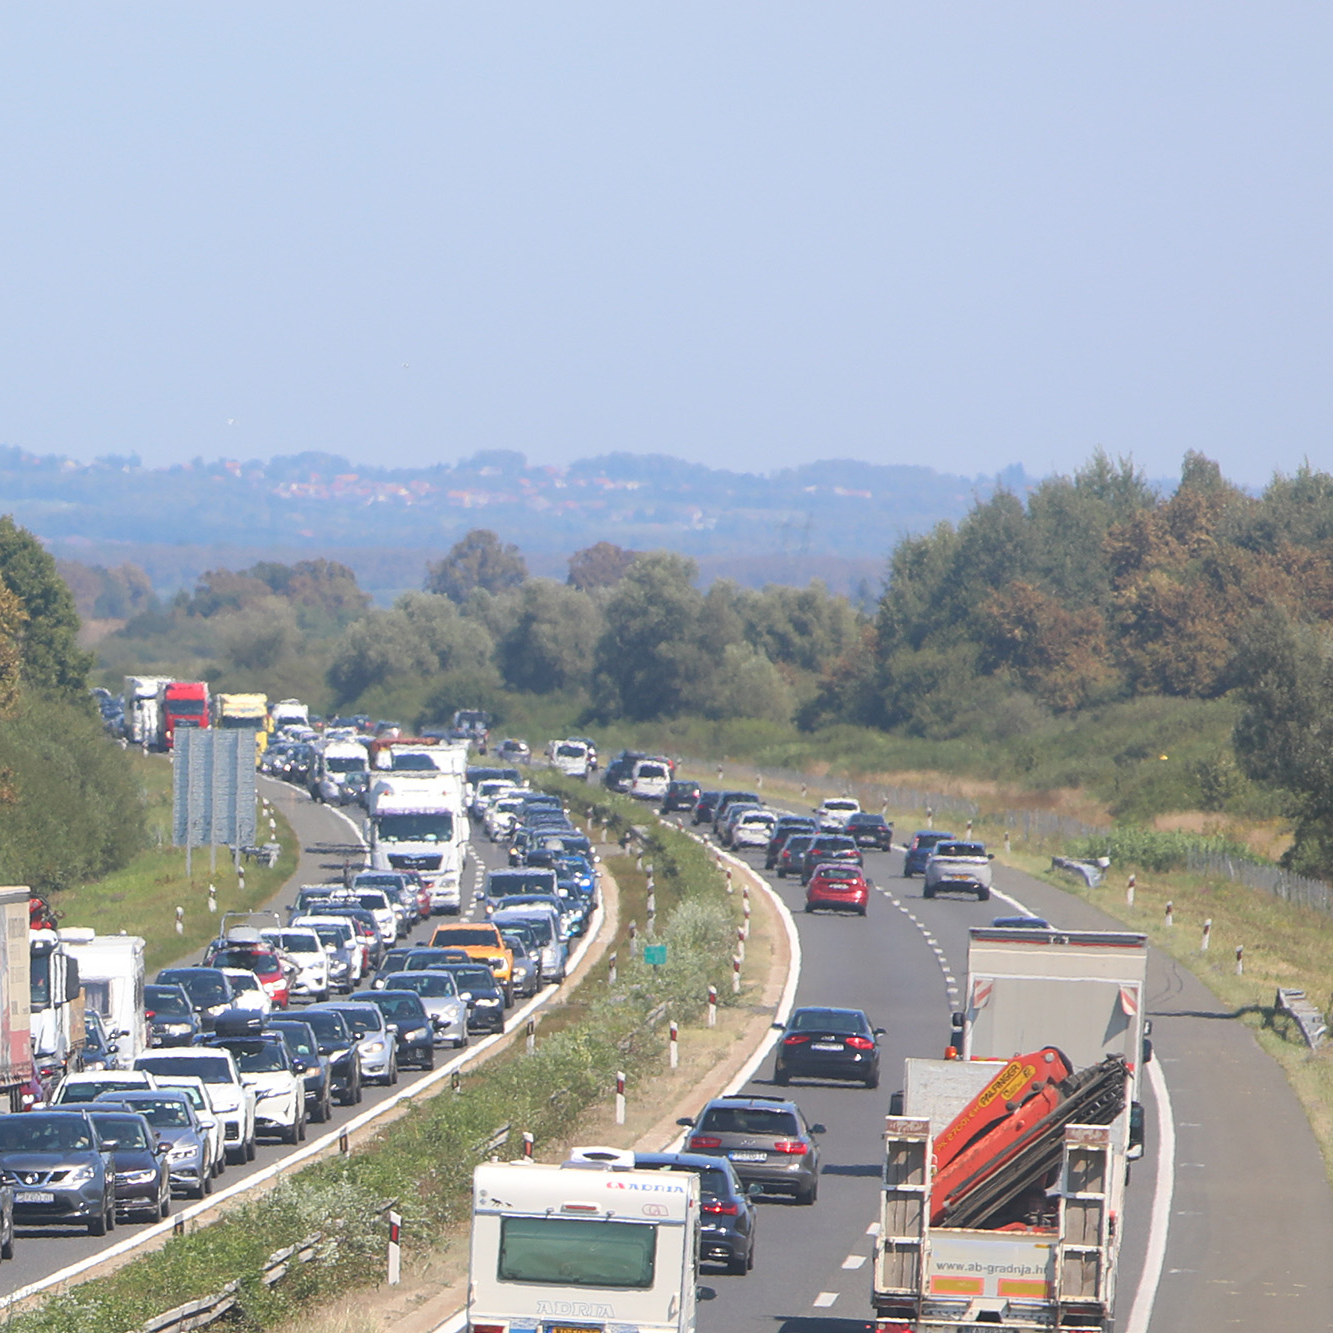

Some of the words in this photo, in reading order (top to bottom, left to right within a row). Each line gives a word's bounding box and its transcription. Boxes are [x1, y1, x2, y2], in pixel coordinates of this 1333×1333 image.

[979, 1064, 1020, 1106] PALFINGER
[628, 1183, 684, 1193] ADRIA
[936, 1261, 1048, 1277] www.ab-gradnja.hr
[537, 1300, 615, 1319] ADRIA
